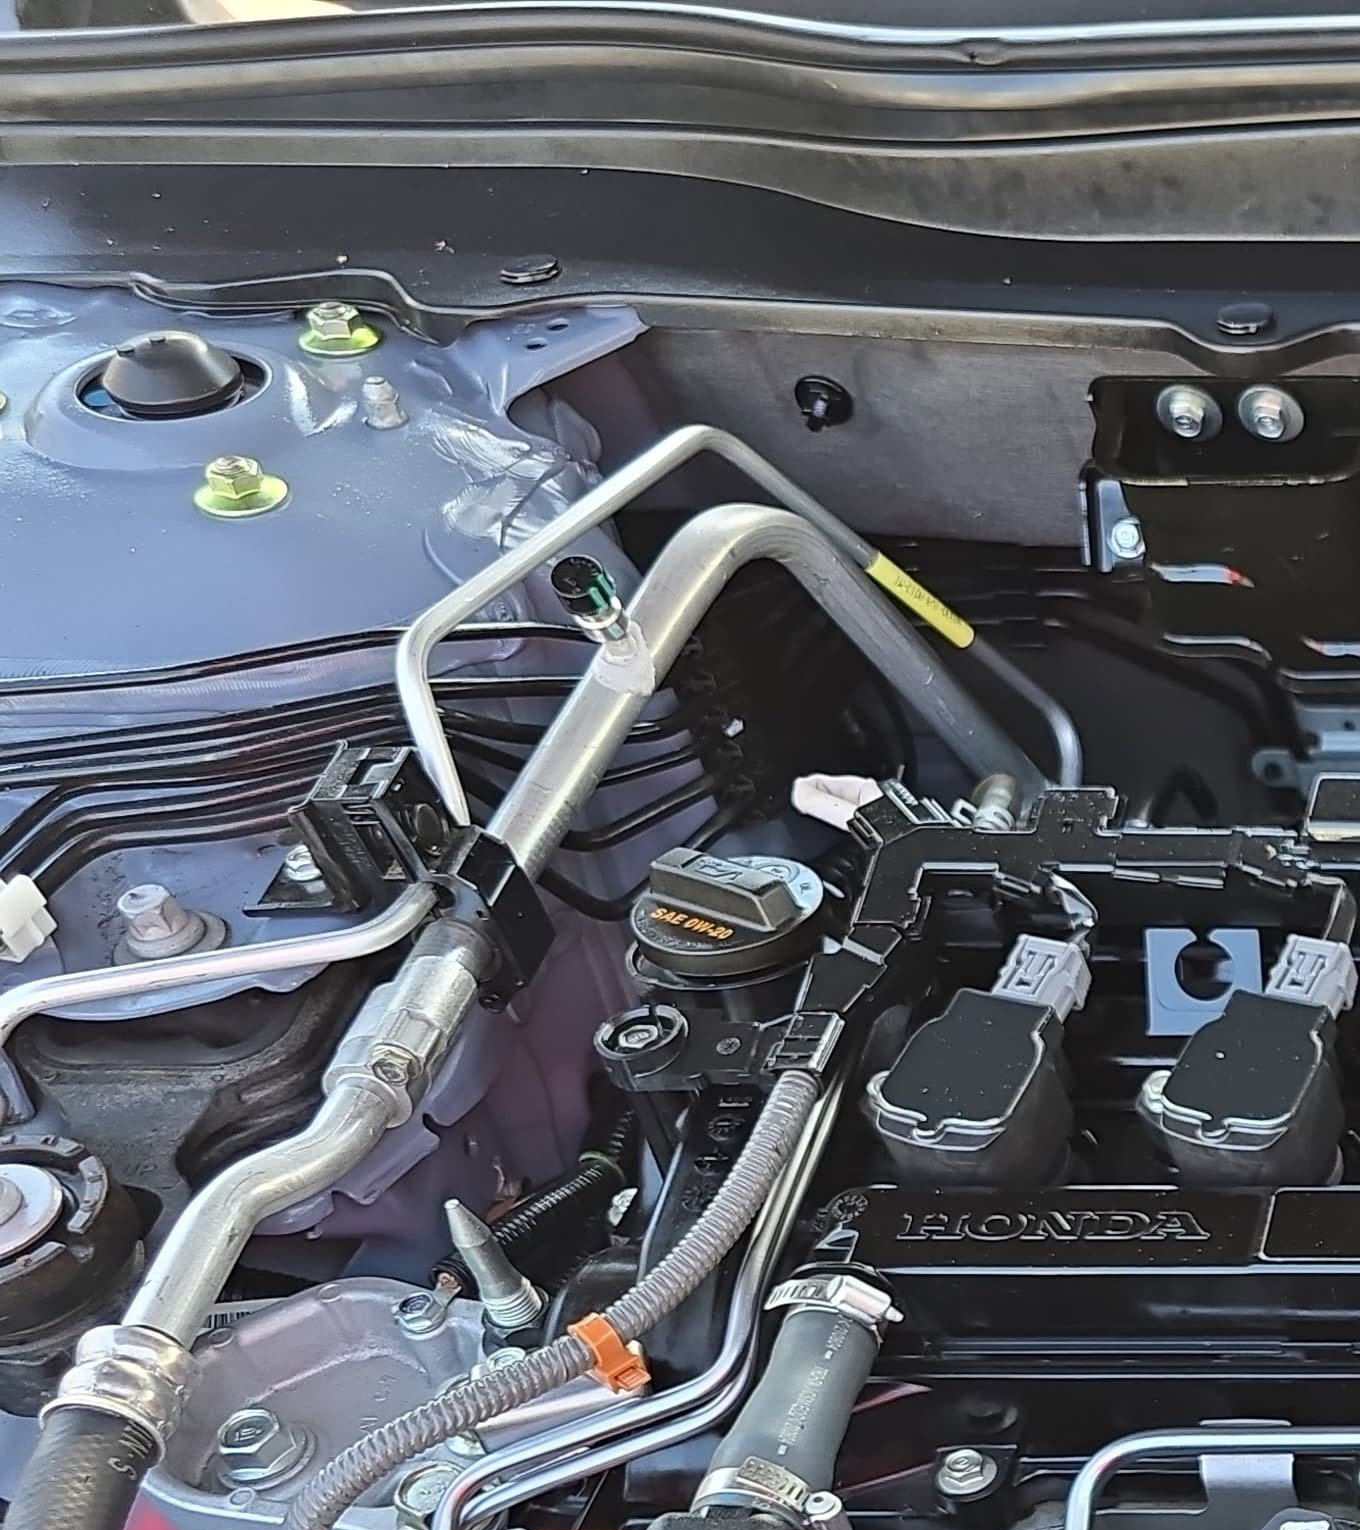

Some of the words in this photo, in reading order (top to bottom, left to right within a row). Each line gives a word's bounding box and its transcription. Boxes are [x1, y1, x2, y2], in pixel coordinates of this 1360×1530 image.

[650, 908, 688, 925] SAE
[684, 918, 734, 940] 0W-20
[896, 1210, 1211, 1241] HONDA
